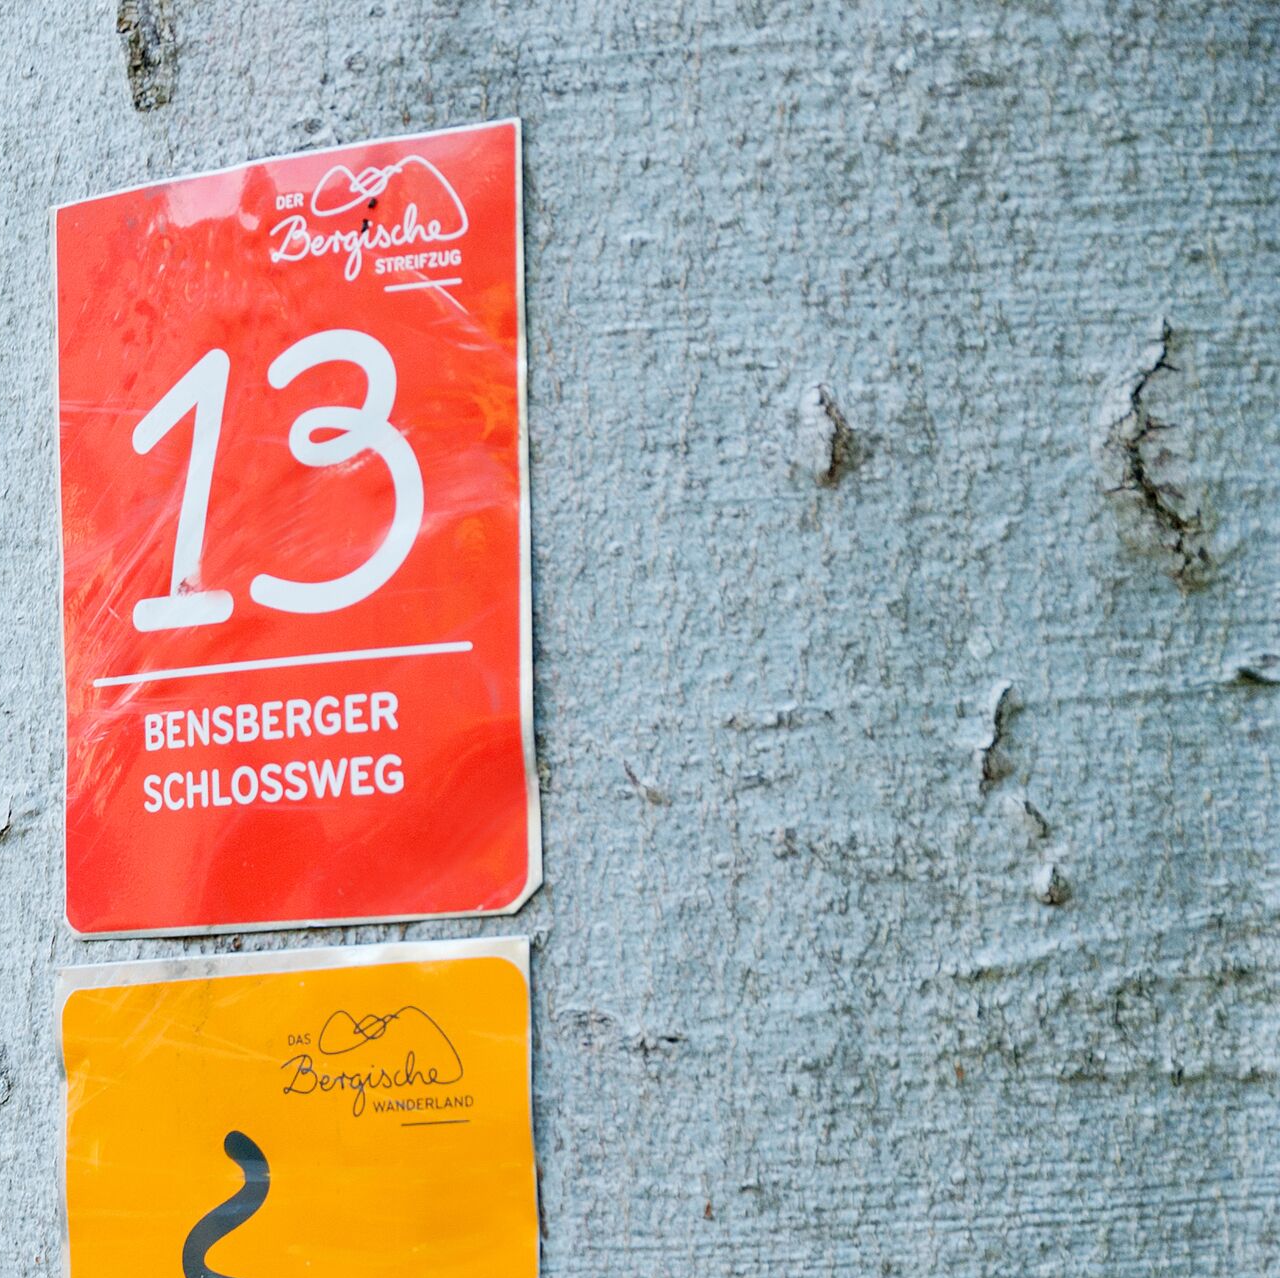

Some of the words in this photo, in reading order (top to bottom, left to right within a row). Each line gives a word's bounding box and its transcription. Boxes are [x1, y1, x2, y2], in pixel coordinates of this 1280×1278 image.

[275, 192, 304, 210] DER
[269, 202, 442, 281] Bergische
[375, 249, 462, 275] STREIFZUG
[132, 328, 425, 633] 13
[144, 691, 399, 752] BENSBERGER
[143, 754, 405, 814] SCHLOSSWEG
[287, 1033, 312, 1047] DAS
[280, 1050, 439, 1118] Bergische
[372, 1094, 475, 1114] WANDERLAND
